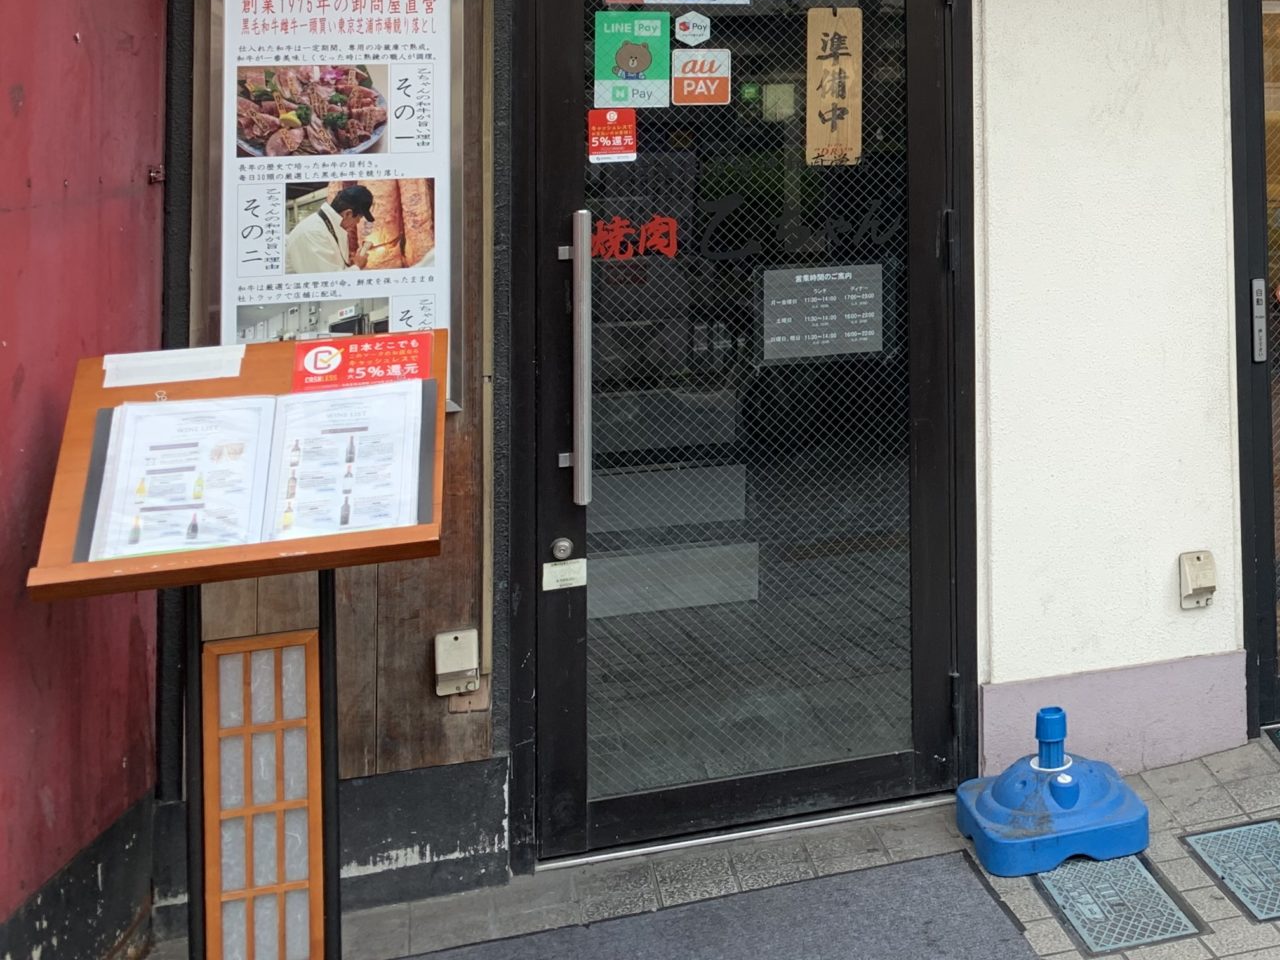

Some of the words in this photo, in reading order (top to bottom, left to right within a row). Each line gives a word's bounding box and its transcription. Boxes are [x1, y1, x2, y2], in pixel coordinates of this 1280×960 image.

[603, 23, 632, 33] LINE
[638, 24, 658, 33] Pay
[692, 23, 708, 32] Pay
[681, 59, 722, 74] au
[683, 79, 720, 96] PAY
[815, 31, 852, 133] 準備中
[631, 88, 653, 100] Pay
[393, 77, 415, 140] その一
[591, 136, 634, 147] 5%還元
[241, 198, 264, 263] その二
[795, 271, 853, 283] 営業時間のご案内
[1255, 288, 1264, 306] 自動
[348, 339, 420, 353] 日本どこでも
[355, 362, 420, 379] 5%還元
